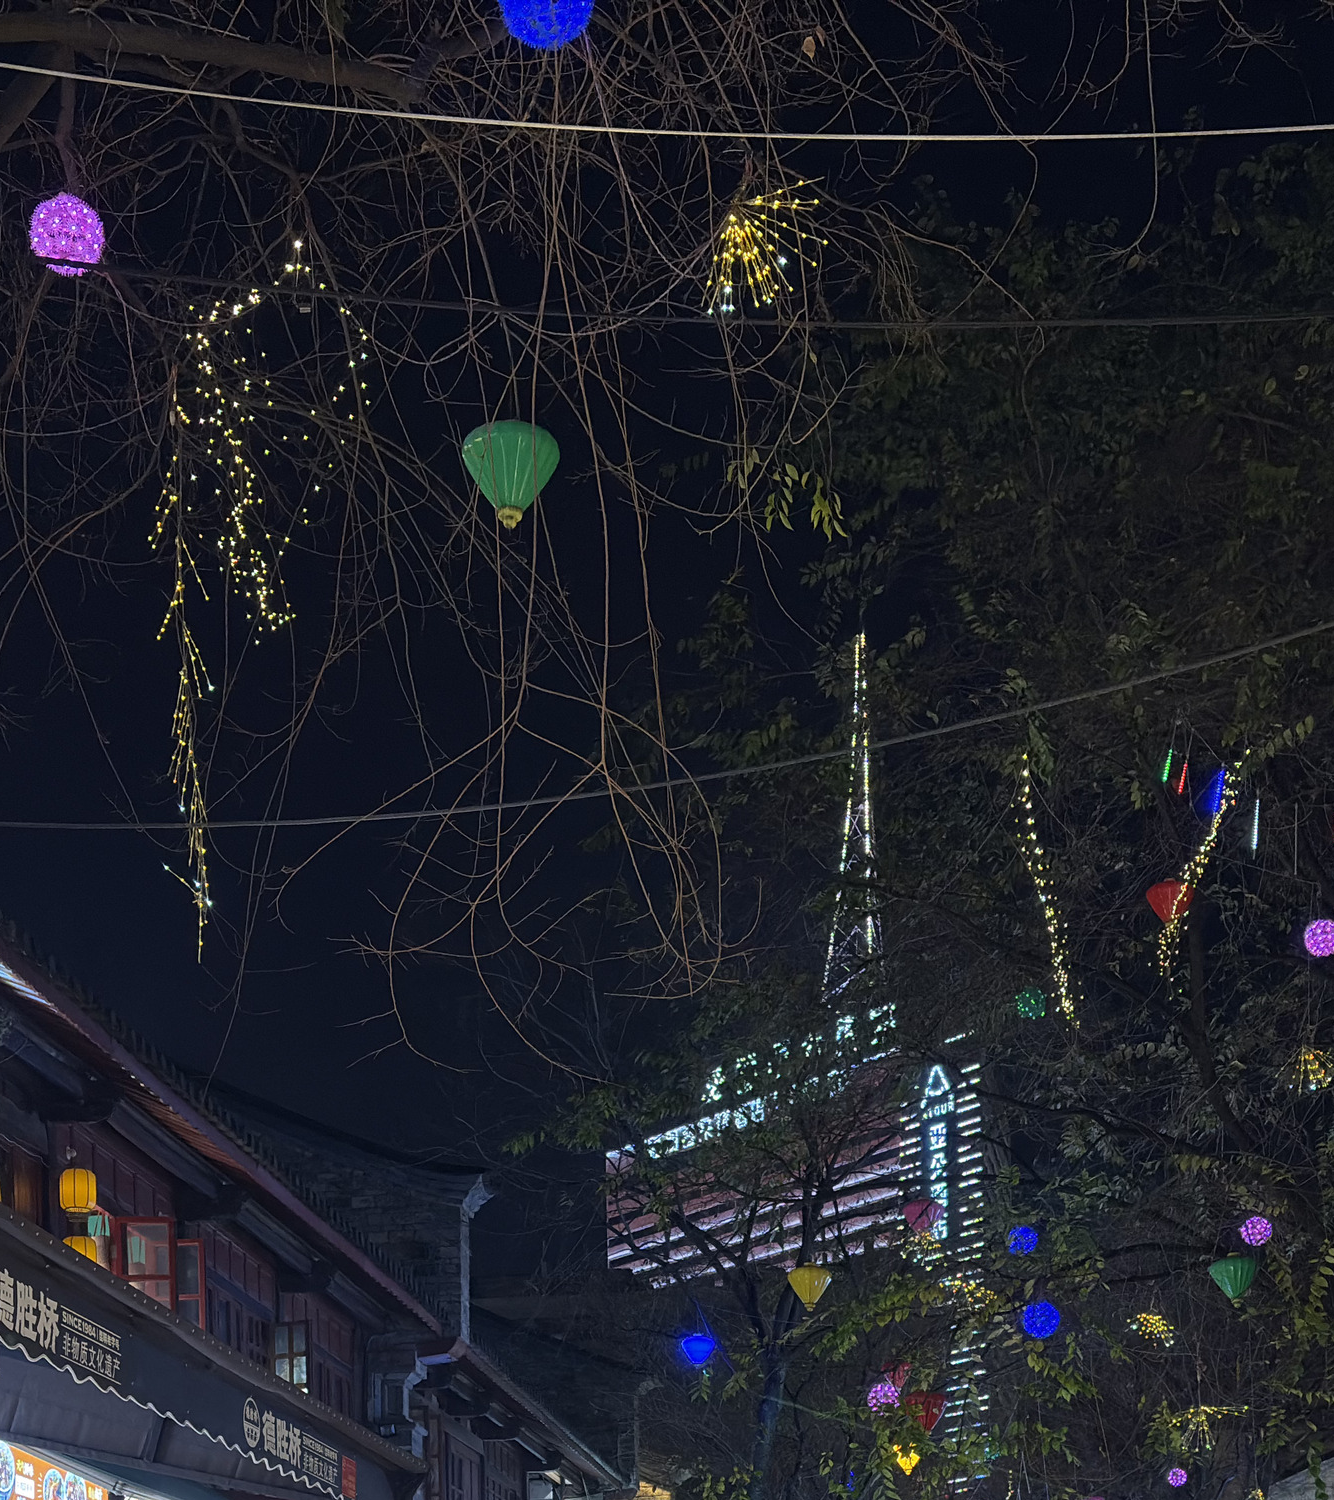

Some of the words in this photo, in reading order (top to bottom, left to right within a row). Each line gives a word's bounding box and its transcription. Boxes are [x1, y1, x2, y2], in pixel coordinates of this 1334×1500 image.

[62, 1311, 96, 1339] SINCE1984
[63, 1332, 121, 1378] 非物质文化遗产
[262, 1410, 302, 1468] 德胜桥
